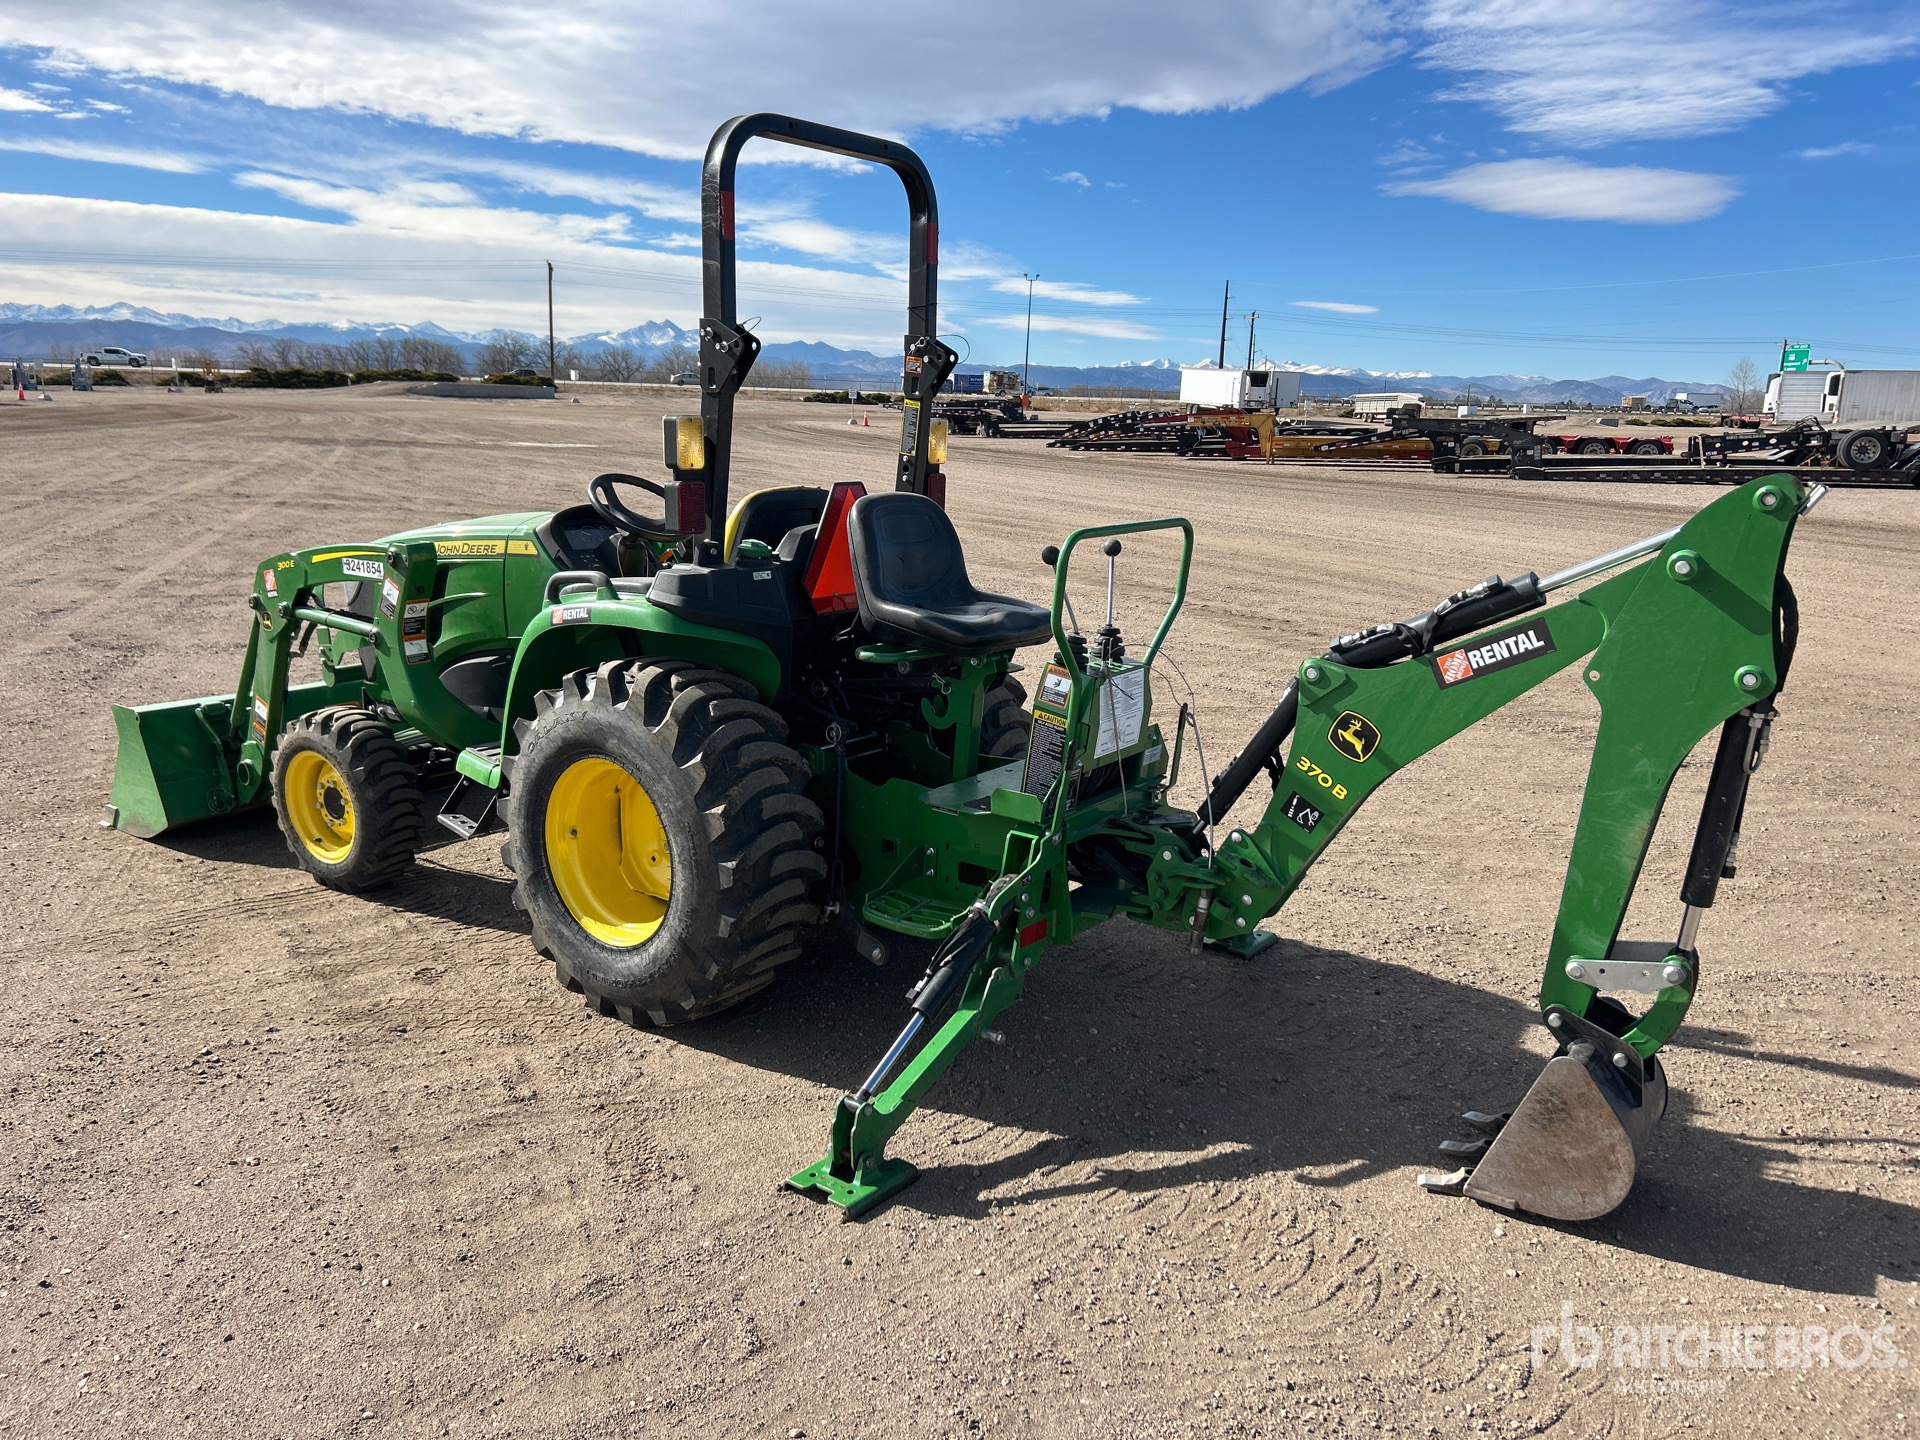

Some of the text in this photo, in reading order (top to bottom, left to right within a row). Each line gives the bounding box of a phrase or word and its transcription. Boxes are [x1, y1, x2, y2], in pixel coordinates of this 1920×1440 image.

[437, 542, 497, 555] JOHN DEERE
[277, 559, 295, 570] 300 E
[345, 559, 382, 575] 3241854
[563, 607, 589, 620] RENTAL
[1466, 629, 1545, 670] RENTAL
[1445, 651, 1464, 682] HOME
[1043, 713, 1067, 727] CAUTION
[1295, 755, 1348, 800] 370 B
